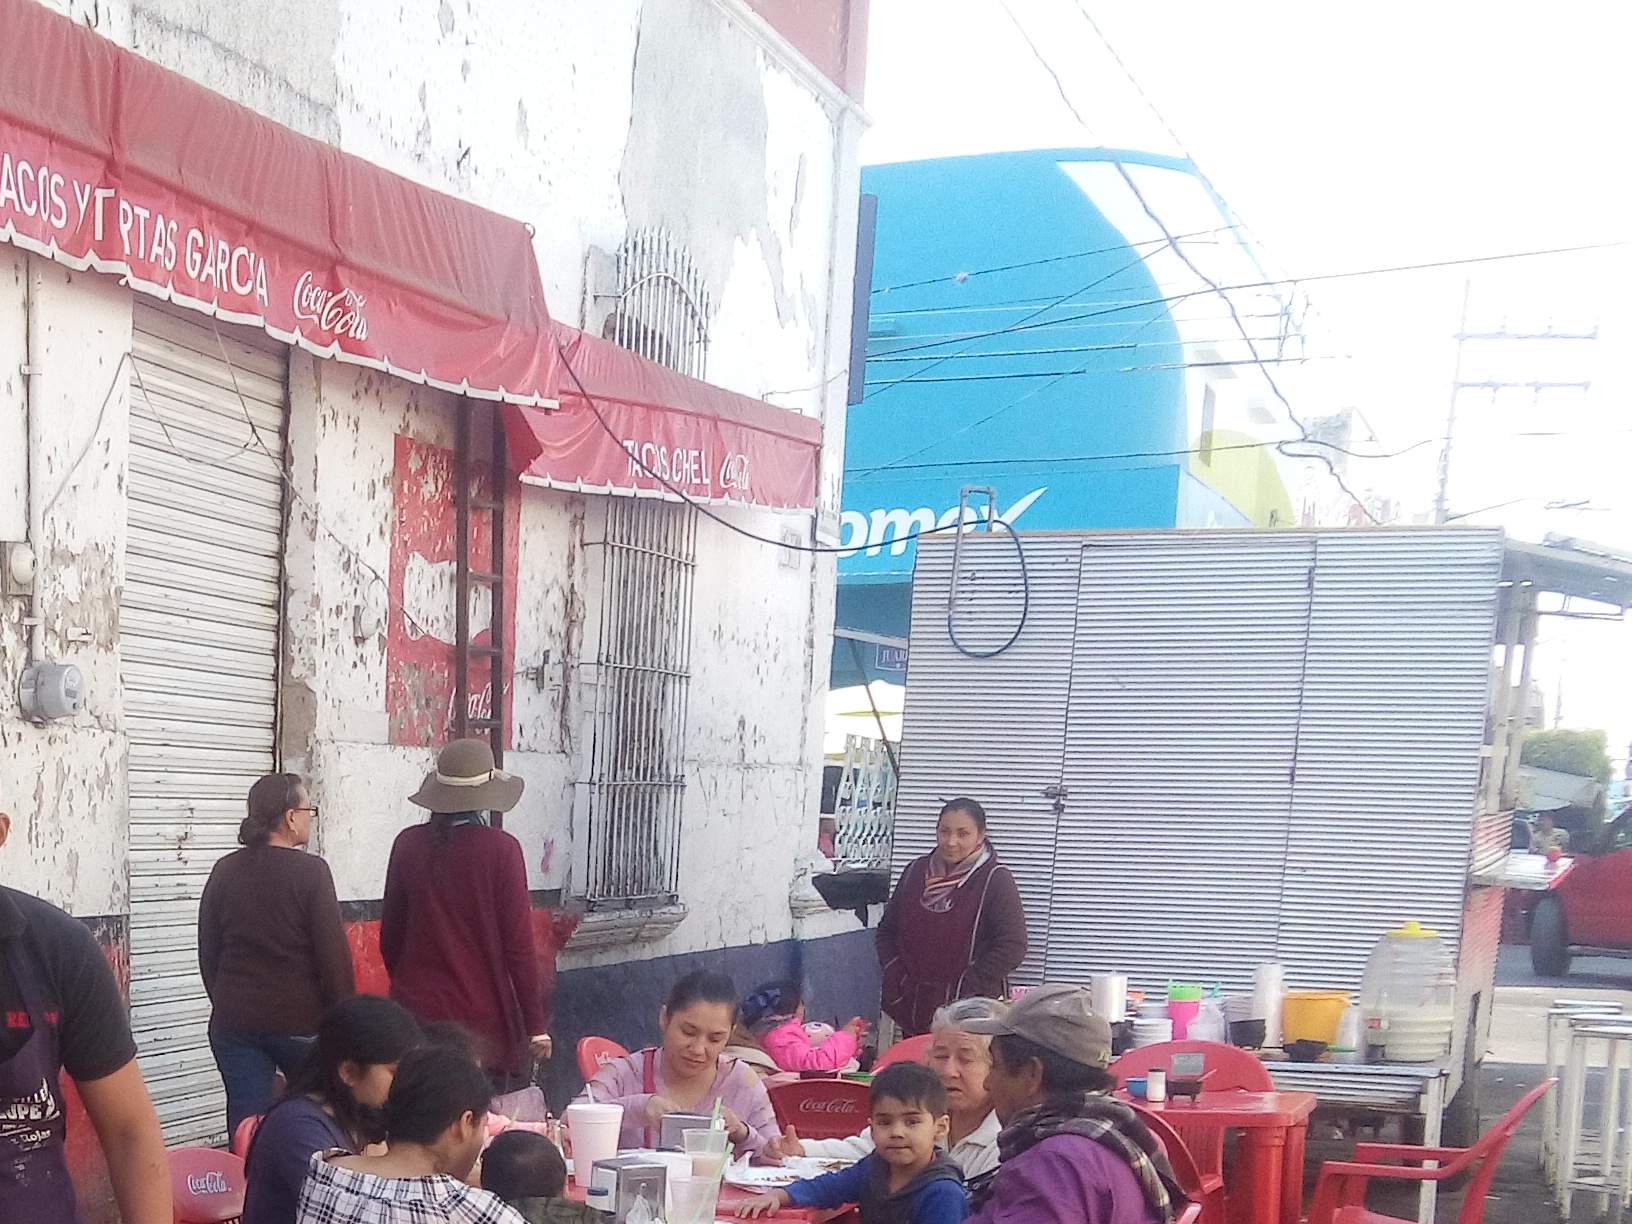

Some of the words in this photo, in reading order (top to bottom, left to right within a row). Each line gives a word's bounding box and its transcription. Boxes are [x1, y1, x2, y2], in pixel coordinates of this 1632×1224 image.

[72, 179, 91, 235] Y
[293, 270, 368, 342] Coca-Cola
[838, 486, 1049, 559] omex
[799, 1097, 858, 1113] Coca-Cola
[187, 1171, 227, 1195] Coca-Cola
